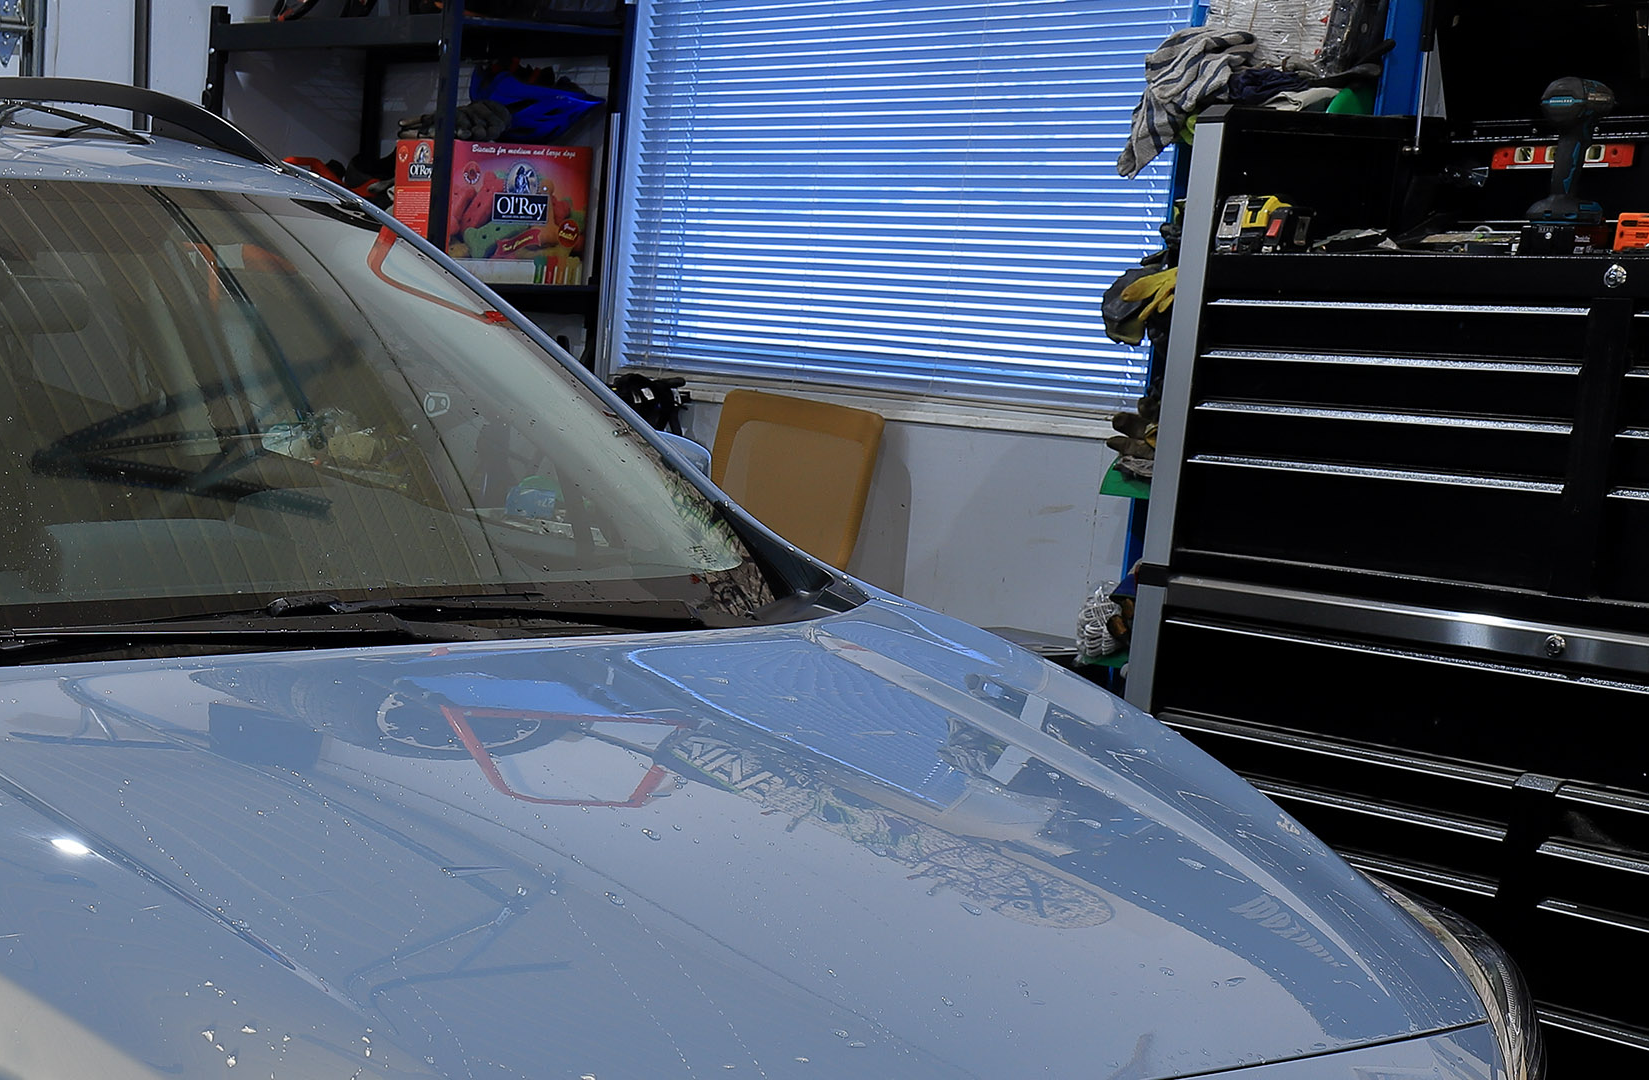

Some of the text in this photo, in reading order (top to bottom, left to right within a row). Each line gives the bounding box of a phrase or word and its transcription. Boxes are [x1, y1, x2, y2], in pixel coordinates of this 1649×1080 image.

[472, 144, 576, 159] Biscuits for medium and large dogs
[496, 196, 546, 221] Ol'Roy
